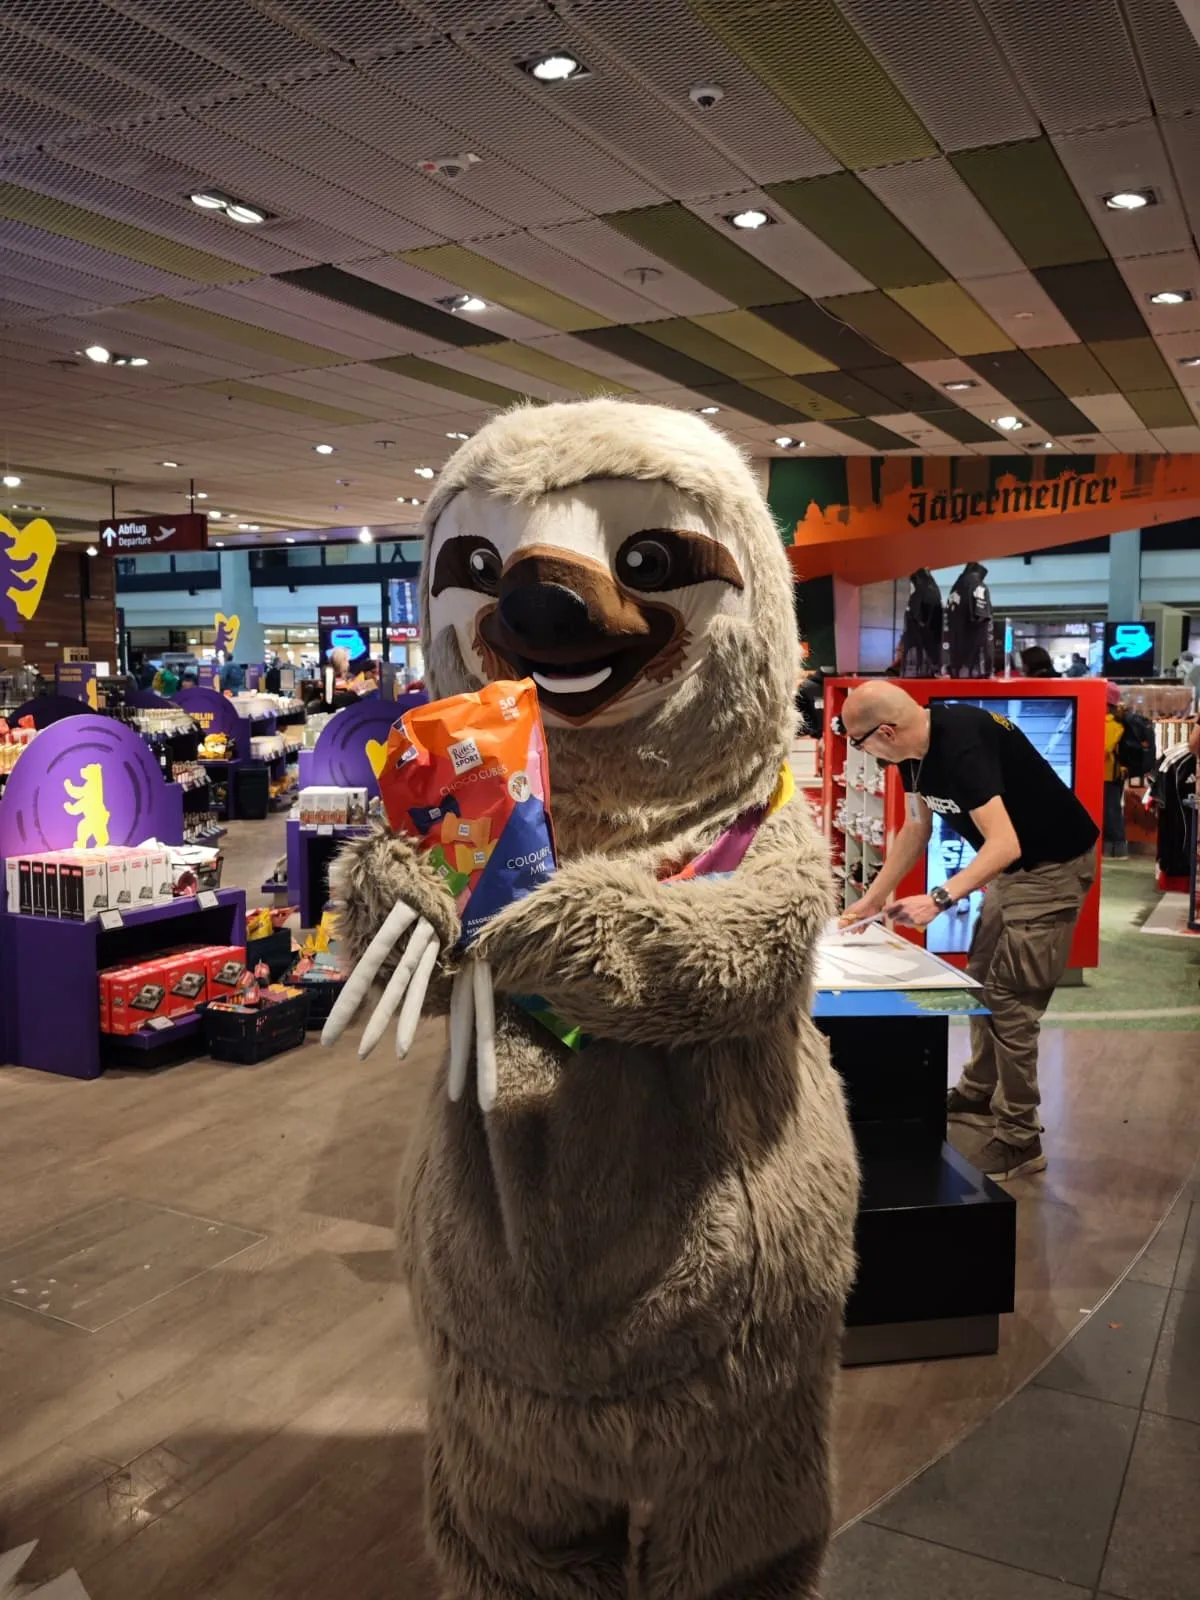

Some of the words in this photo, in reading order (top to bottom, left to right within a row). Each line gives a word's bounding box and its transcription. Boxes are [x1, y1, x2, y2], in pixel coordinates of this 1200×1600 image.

[907, 474, 1117, 528] Jägermeister
[118, 522, 147, 537] Abflug
[118, 536, 152, 548] Departure
[451, 742, 476, 760] Ritter
[455, 754, 480, 768] SPORT
[478, 763, 509, 780] CUBES
